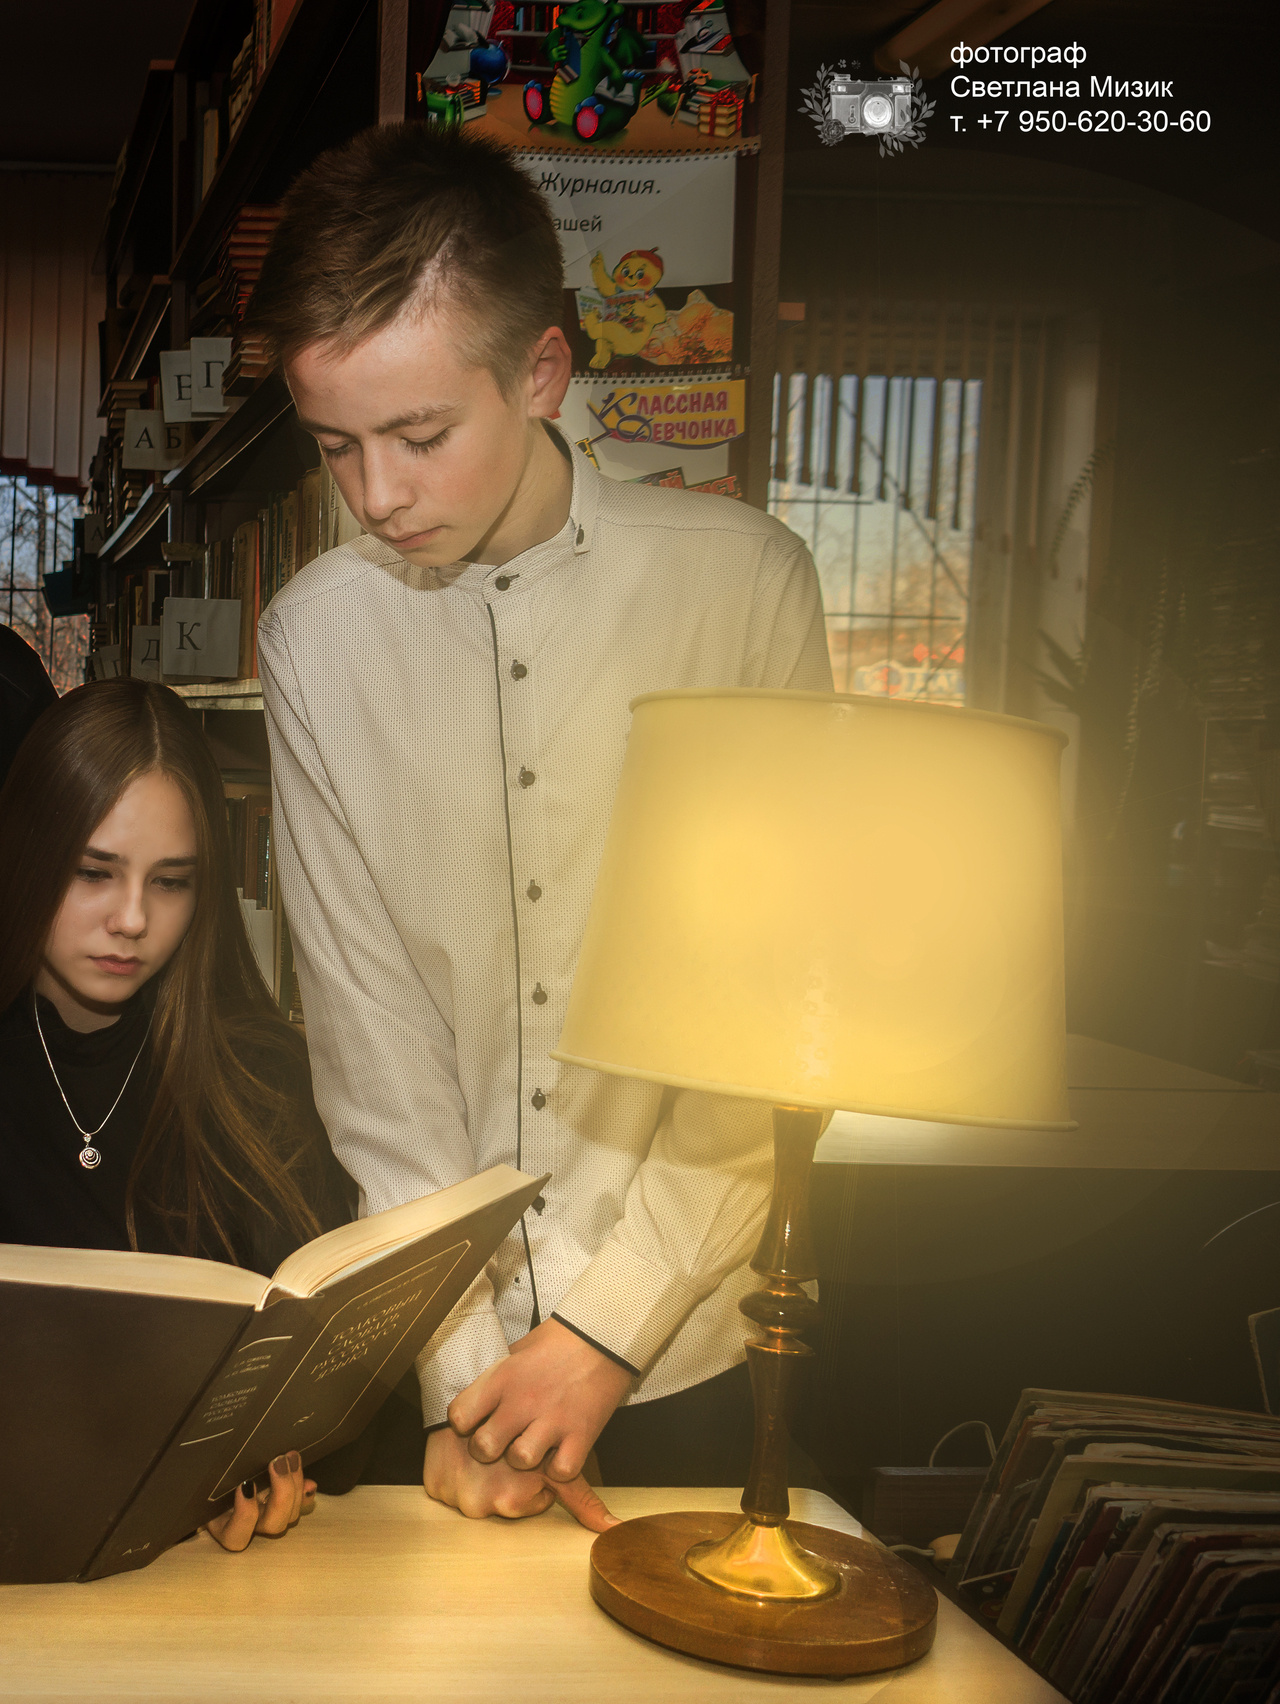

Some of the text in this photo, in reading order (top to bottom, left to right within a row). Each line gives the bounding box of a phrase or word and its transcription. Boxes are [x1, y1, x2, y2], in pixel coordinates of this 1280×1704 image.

[537, 171, 661, 197] Журналия.
[553, 214, 602, 233] ашей
[203, 361, 224, 388] Г
[597, 391, 728, 421] КЛАССНАЯ
[135, 427, 154, 449] А
[166, 427, 181, 449] Б
[616, 414, 738, 443] ДЕВЧОНКА
[176, 621, 201, 651] К
[331, 1289, 422, 1344] ТОЛКОВЫЙ
[328, 1313, 400, 1355] СЛОВАРЬ
[310, 1323, 397, 1375] РУССКОГО
